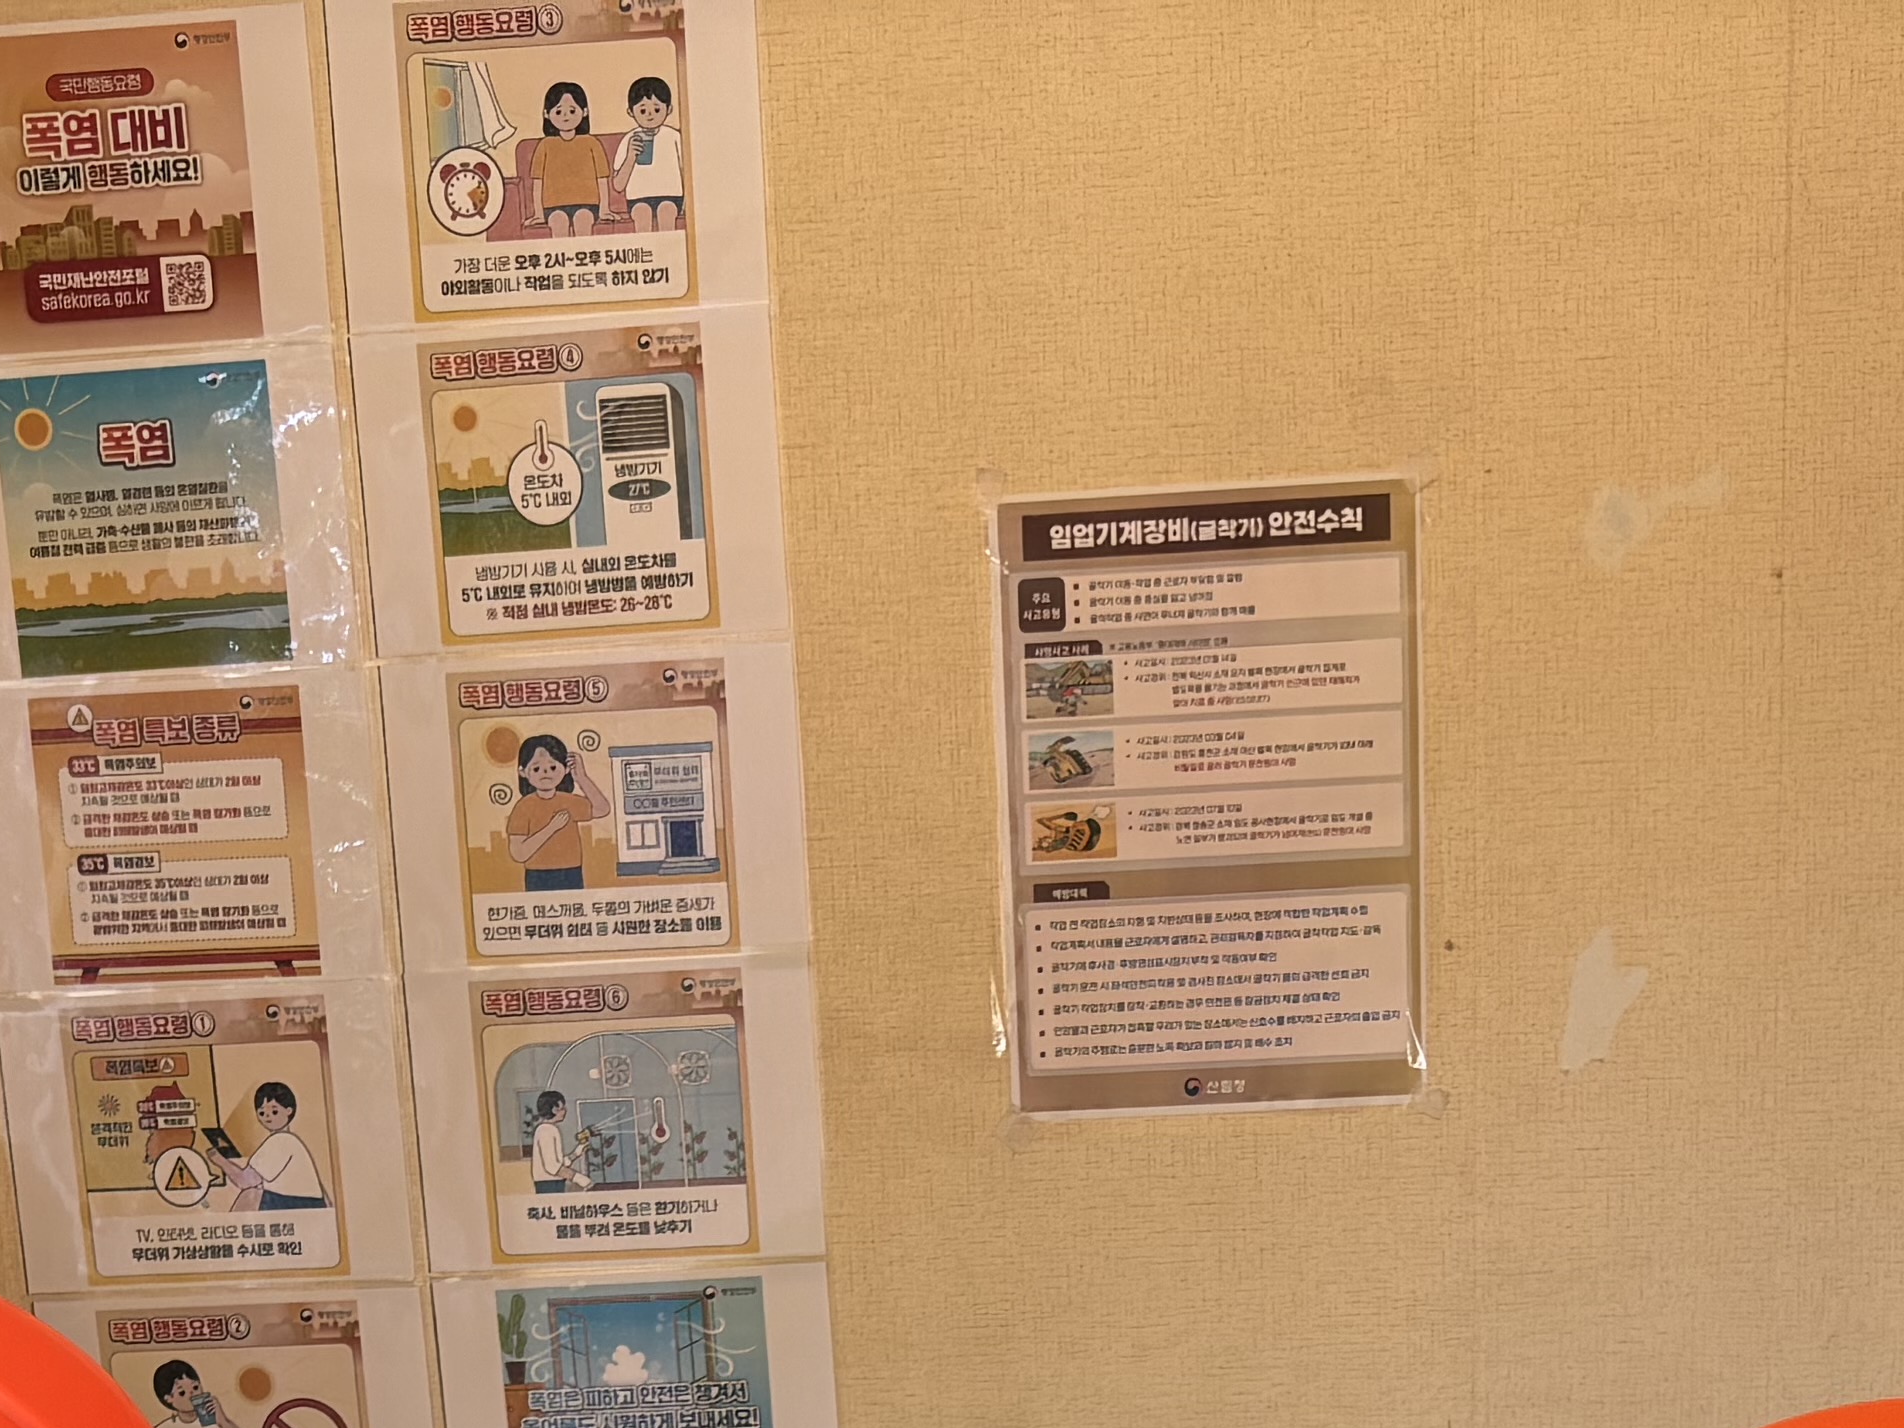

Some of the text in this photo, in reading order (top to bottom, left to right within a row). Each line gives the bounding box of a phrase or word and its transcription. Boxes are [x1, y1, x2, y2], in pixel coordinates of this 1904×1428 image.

[409, 14, 450, 39] 폭염
[24, 106, 187, 158] 폭염 대비
[20, 158, 200, 192] 이렇게 행동하세요!
[41, 288, 151, 311] safekorea.go.kr
[434, 355, 472, 377] 폭염
[101, 422, 173, 465] 폭염
[1268, 507, 1363, 535] 안전수칙
[461, 683, 501, 707] 폭염
[111, 1320, 149, 1342] 폭염
